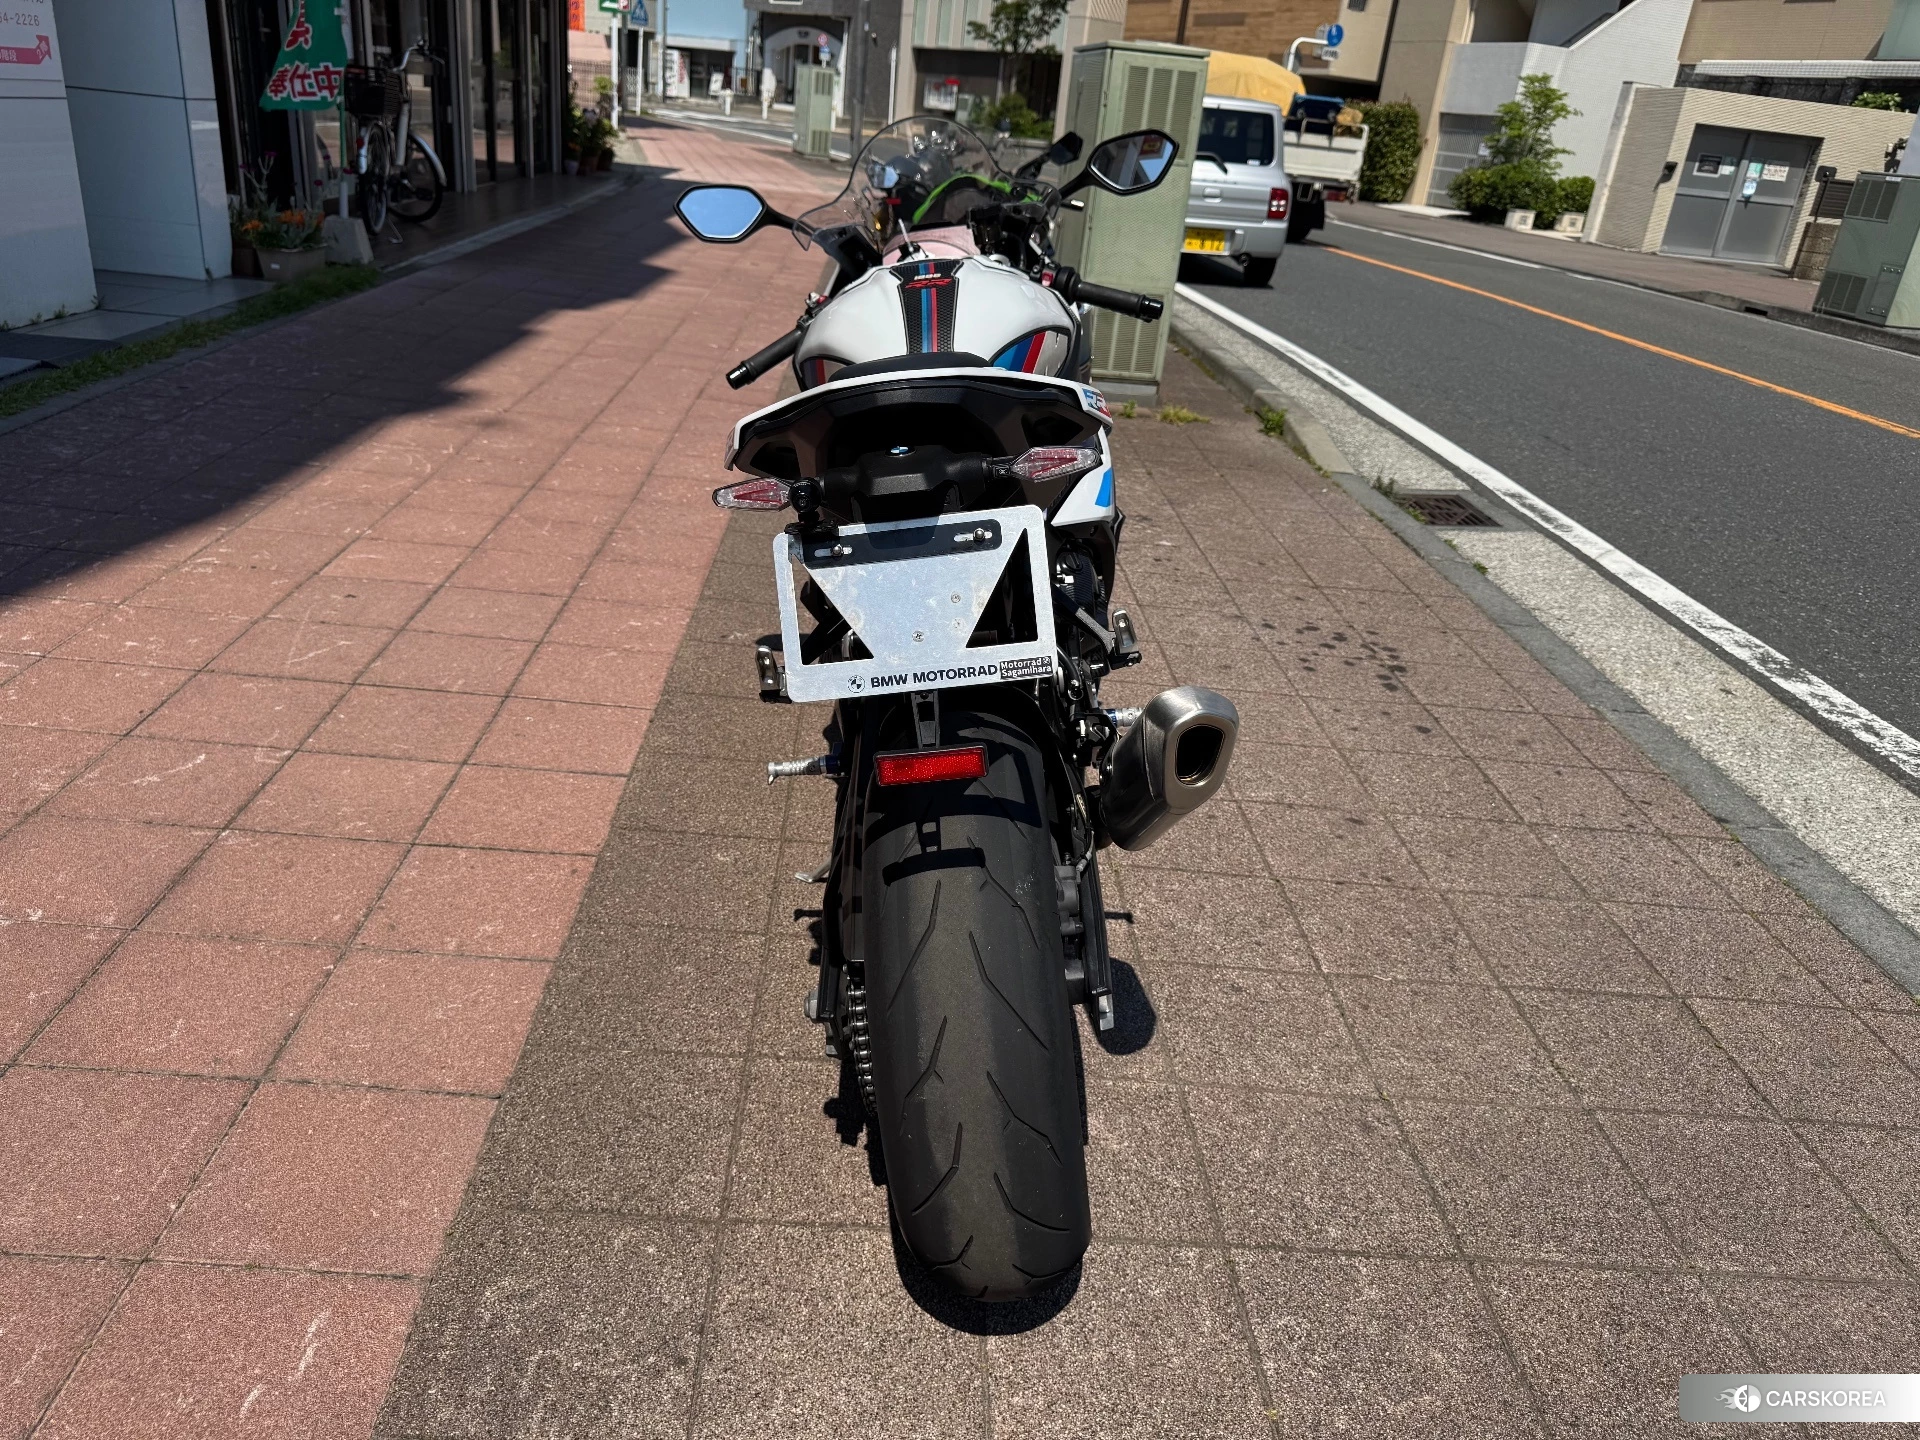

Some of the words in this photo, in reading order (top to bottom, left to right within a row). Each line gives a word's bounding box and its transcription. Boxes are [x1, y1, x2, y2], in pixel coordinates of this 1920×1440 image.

[268, 62, 344, 101] 奉仕中
[1000, 657, 1042, 670] Motorrad
[1001, 664, 1052, 678] Sagamihara
[870, 673, 908, 688] BMW
[912, 664, 998, 684] MOTORRAD
